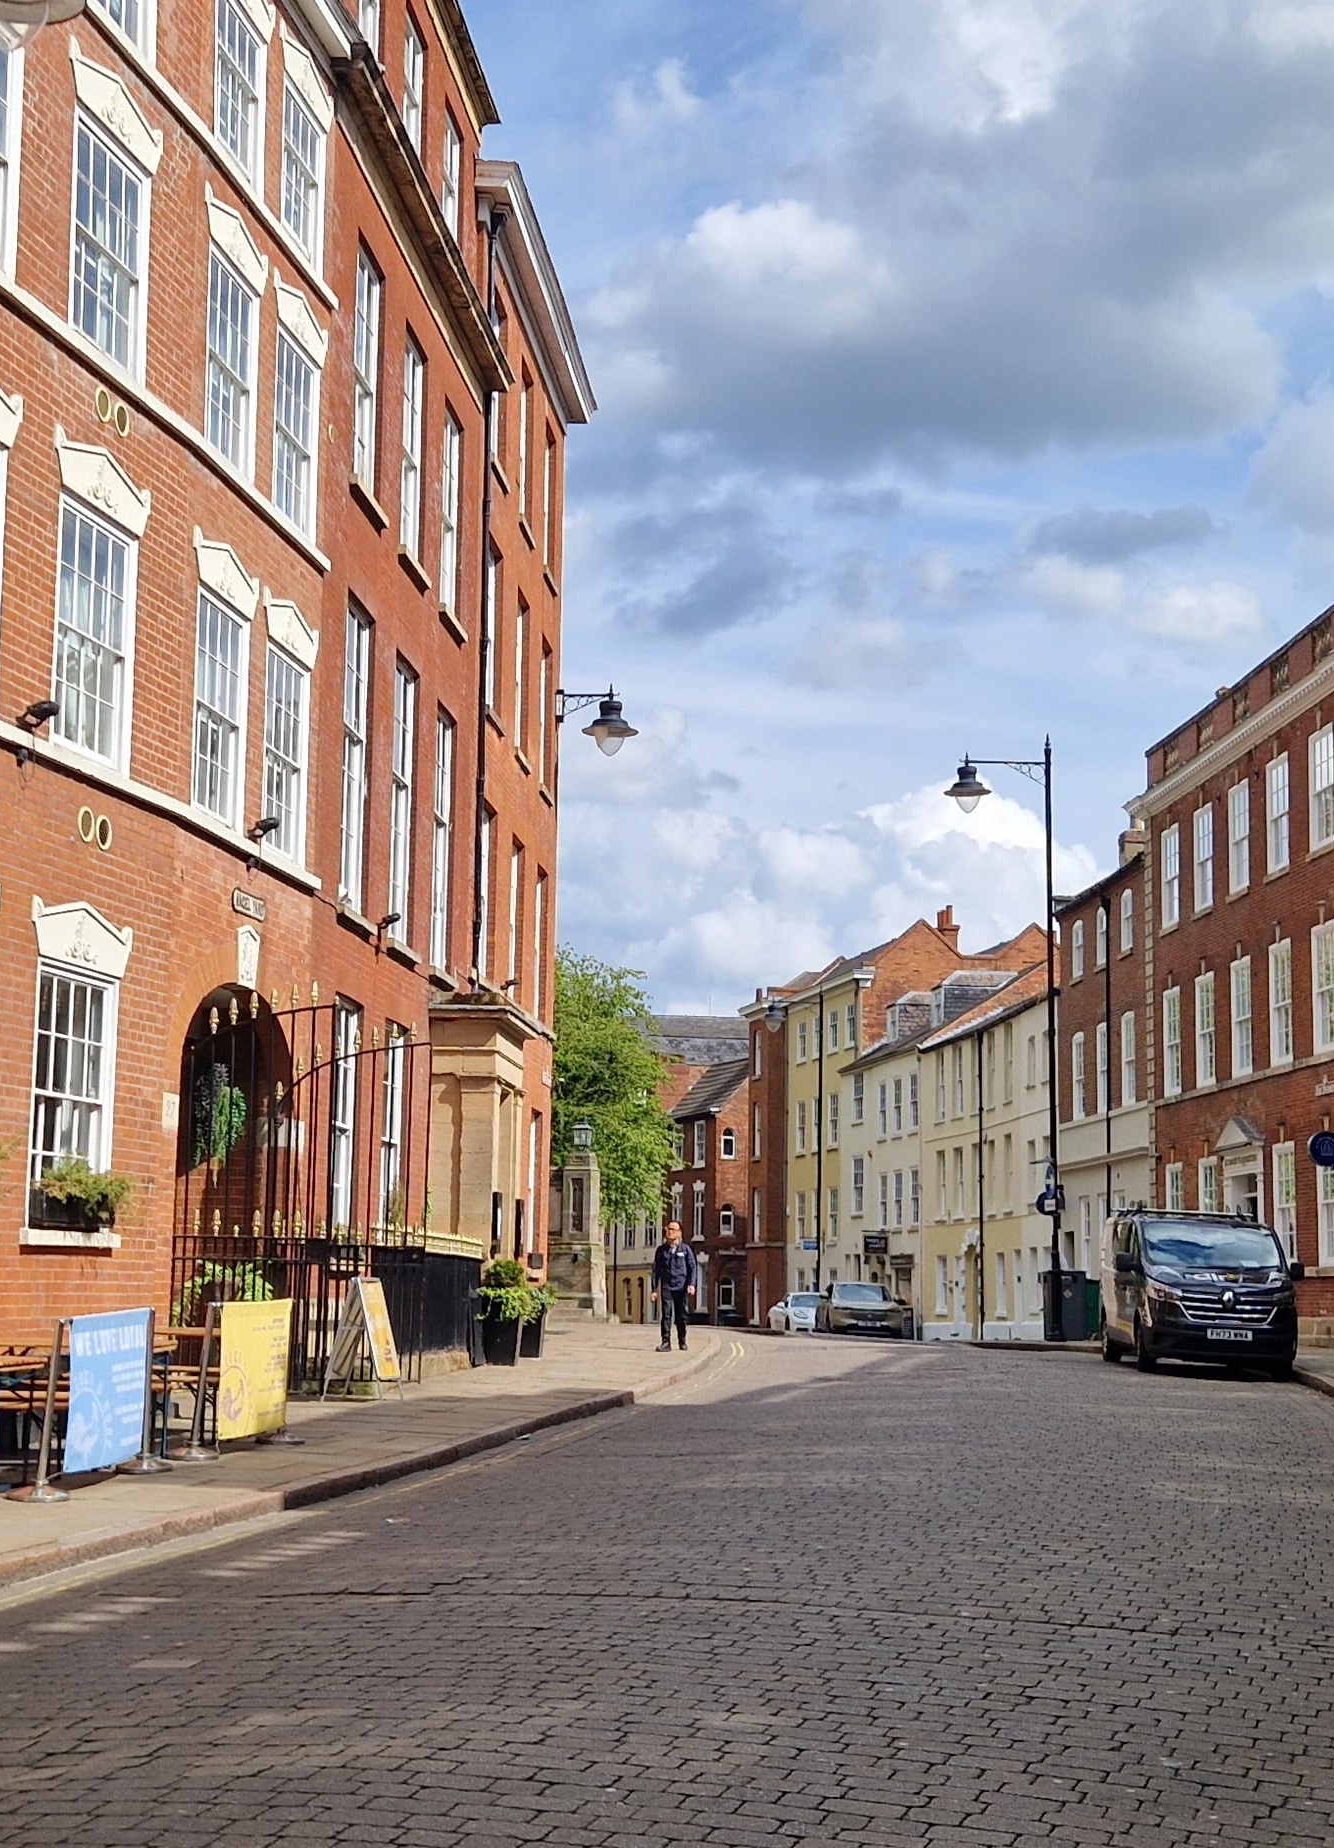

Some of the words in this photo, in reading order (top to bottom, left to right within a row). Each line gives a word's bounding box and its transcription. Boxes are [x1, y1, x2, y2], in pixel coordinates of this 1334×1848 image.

[165, 1100, 176, 1118] 27
[74, 1331, 93, 1358] WE
[94, 1327, 118, 1355] LOVE
[1210, 1330, 1231, 1340] FH73
